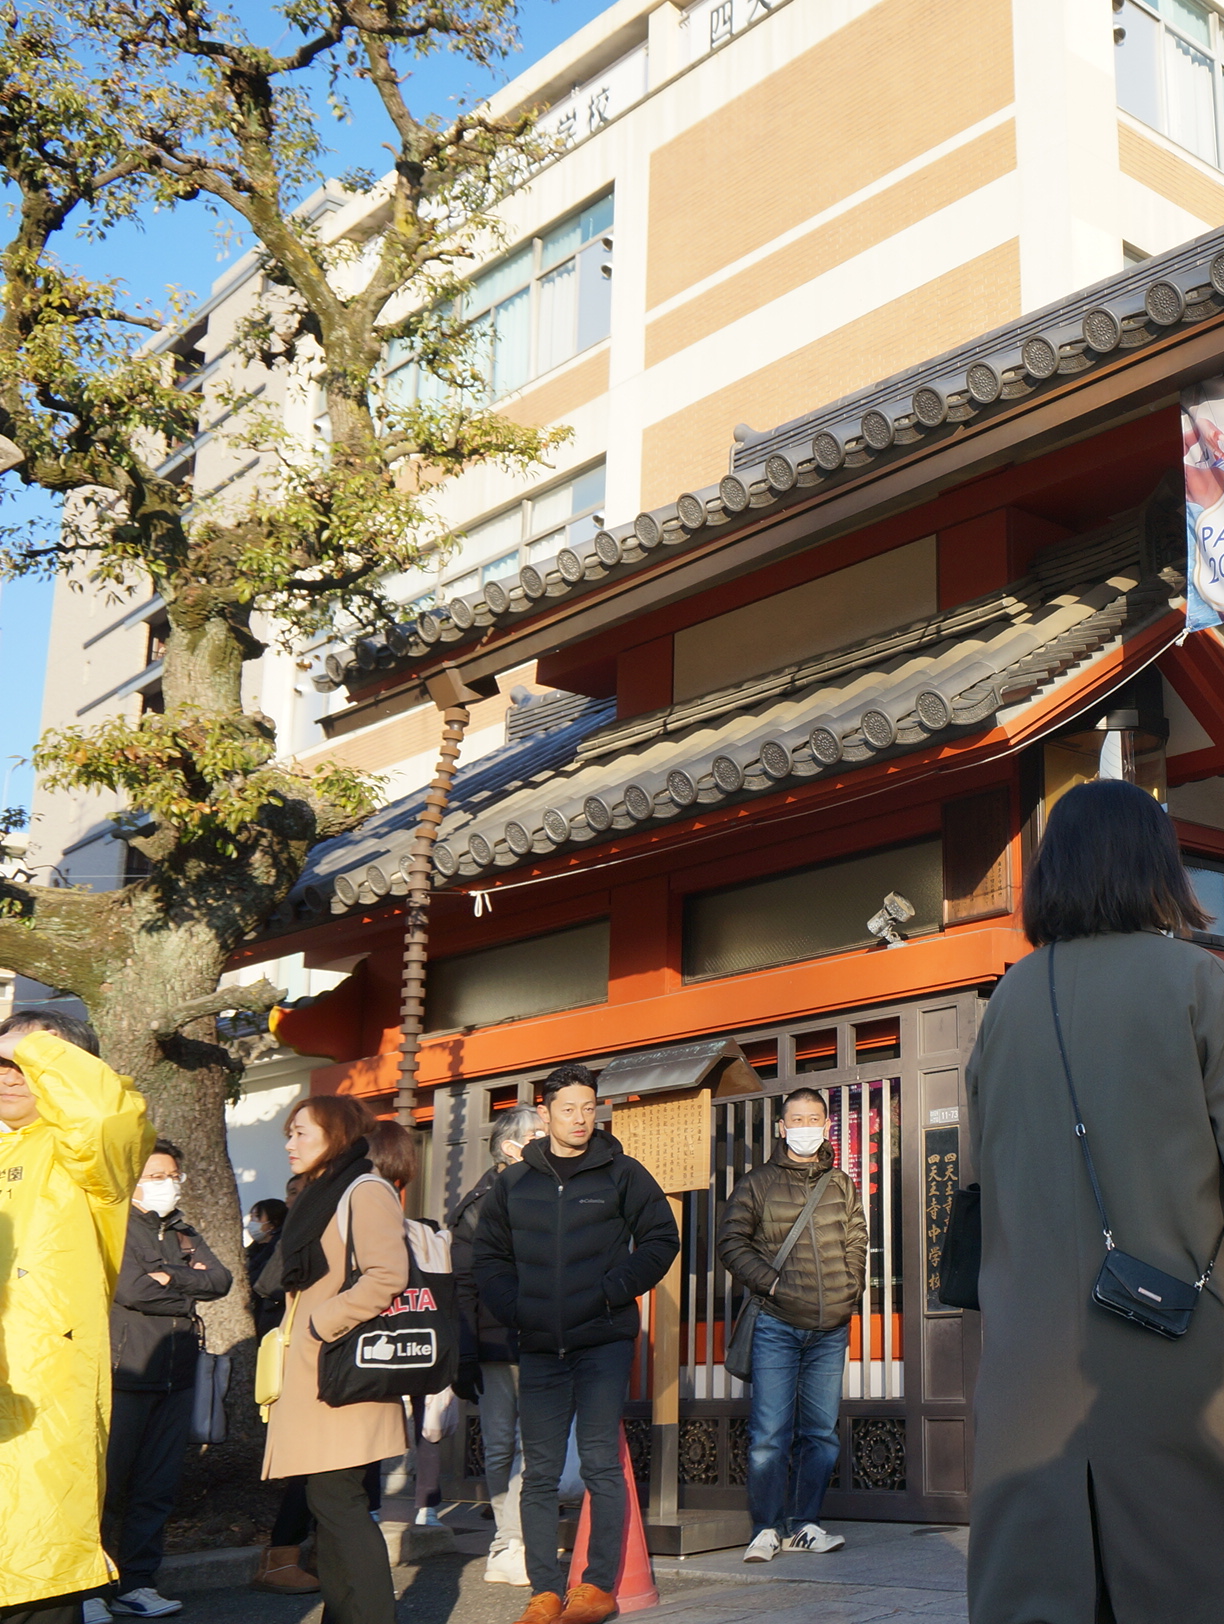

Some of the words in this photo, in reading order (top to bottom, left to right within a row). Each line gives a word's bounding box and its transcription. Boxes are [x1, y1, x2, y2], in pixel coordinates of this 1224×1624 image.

[926, 1154, 942, 1291] 四天王寺中学校
[379, 1287, 438, 1318] LTA
[396, 1342, 432, 1357] Like
